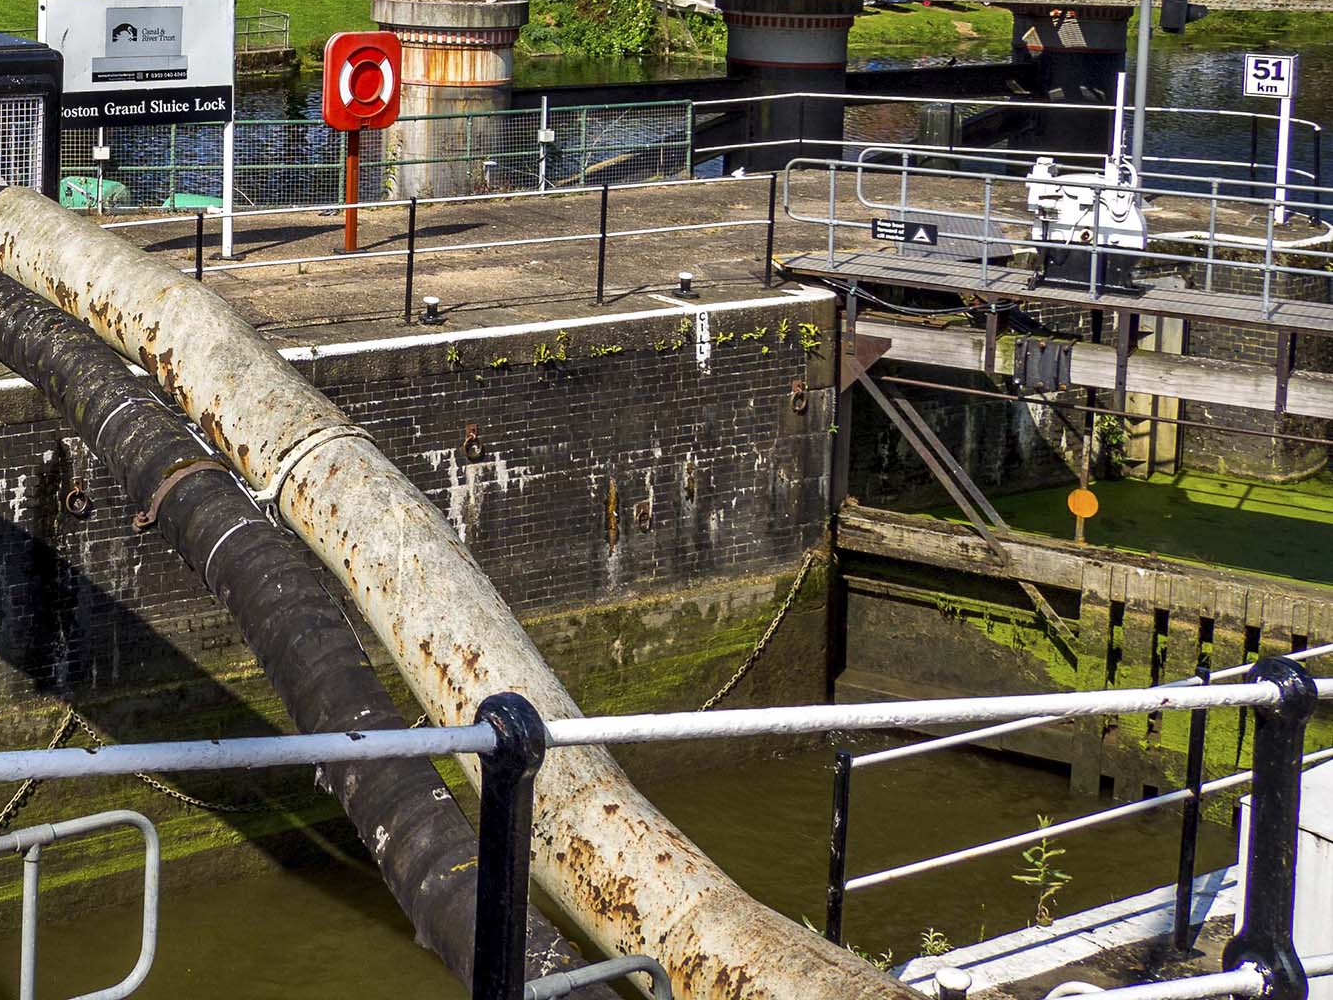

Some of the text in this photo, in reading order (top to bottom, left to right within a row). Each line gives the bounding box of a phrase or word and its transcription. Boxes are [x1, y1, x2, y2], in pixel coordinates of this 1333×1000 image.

[1252, 59, 1285, 81] 51
[1257, 82, 1278, 93] km
[104, 101, 146, 116] Grand
[150, 99, 190, 114] Sluice
[194, 97, 226, 112] Lock
